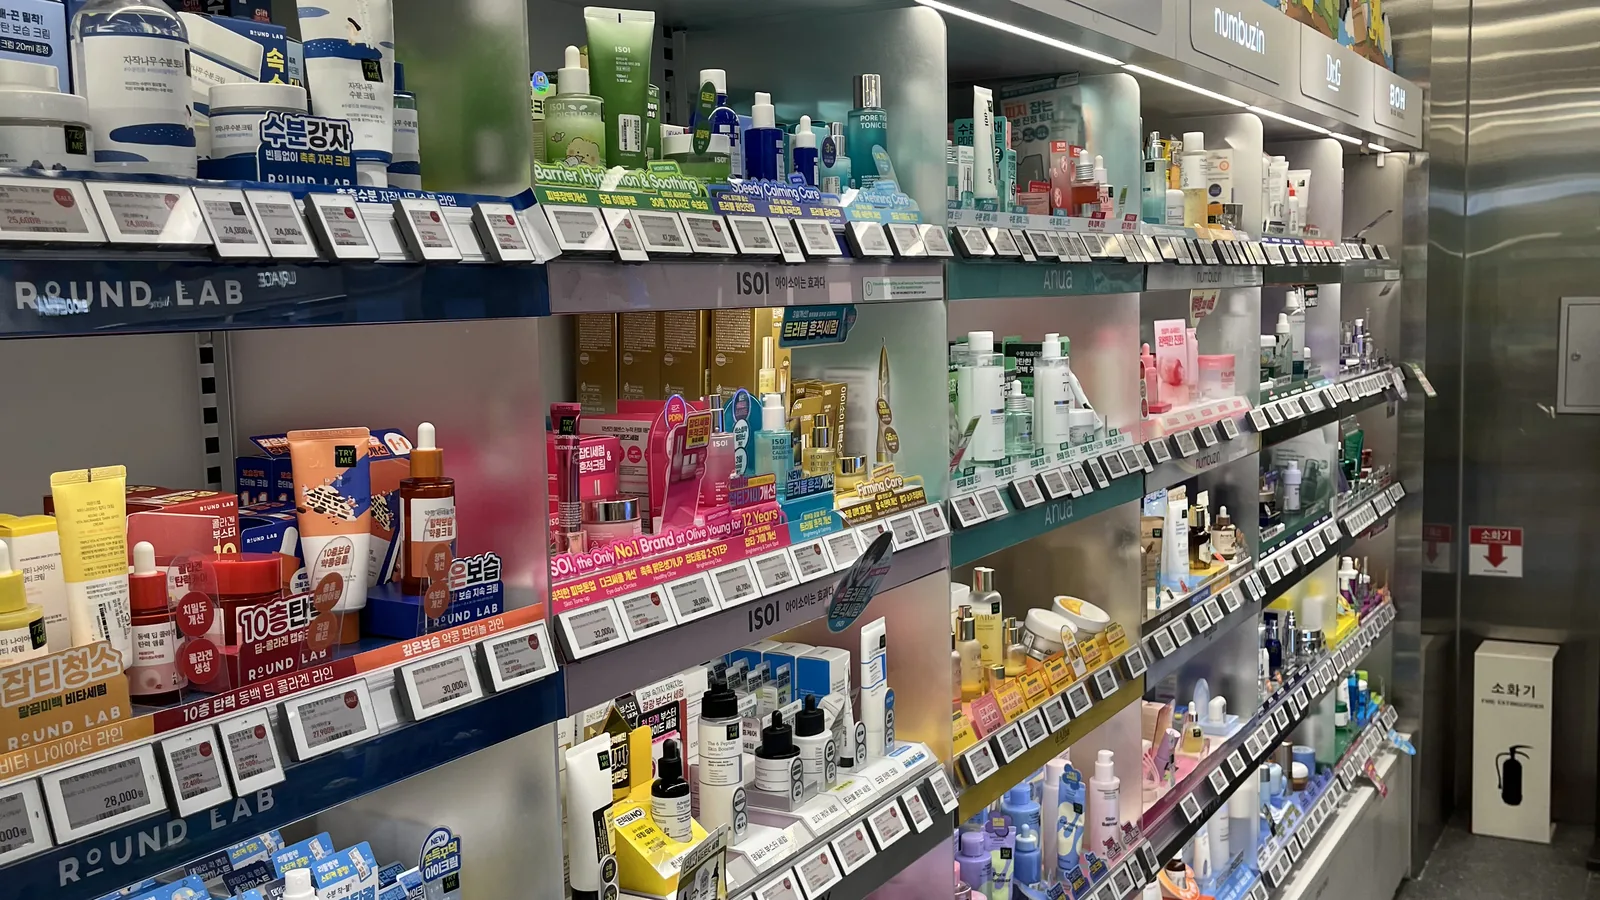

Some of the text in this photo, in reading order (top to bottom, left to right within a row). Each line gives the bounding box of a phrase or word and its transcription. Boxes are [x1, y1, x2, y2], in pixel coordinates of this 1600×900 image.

[1214, 7, 1266, 54] numbuzin
[1030, 100, 1054, 114] 잡는
[262, 114, 351, 151] 수분강자
[265, 149, 351, 167] 빈틈없이 촉촉 자작 크림
[534, 163, 699, 194] Barrier, & Soothing
[731, 181, 820, 201] Speedy Calming Care
[863, 191, 910, 207] Refining Care
[438, 195, 456, 207] 라인
[736, 271, 770, 295] ISOI
[775, 275, 826, 290] 아이소이는 효과다
[1043, 269, 1073, 290] Anua
[15, 280, 152, 310] ROUND
[175, 280, 244, 306] LAB
[783, 319, 840, 338] 트러블 흔적세럼
[562, 418, 574, 426] TRY
[337, 449, 354, 457] TRY
[387, 436, 410, 452] 1+1
[580, 445, 612, 461] 잡티세럼 &
[339, 456, 353, 464] ME
[580, 459, 606, 473] 흔적크림
[855, 475, 904, 497] Firming Care
[1044, 499, 1073, 526] Anua
[212, 516, 235, 530] 콜라겐
[212, 526, 236, 540] 부스터
[576, 509, 778, 570] the Only No.1 Brand at Olive Young for 12 Years
[1481, 530, 1512, 541] 소화기
[706, 544, 728, 558] 2-STEP
[458, 583, 499, 601] 보습 지속 크림
[785, 586, 835, 614] 아이소이는 효과다
[182, 601, 208, 615] 치밀도
[476, 603, 499, 617] LAB
[188, 613, 205, 626] 개선
[748, 604, 780, 633] ISOI
[401, 618, 505, 657] 깊은보습 약콩 판테놀 라인
[188, 649, 214, 665] 콜라겐
[2, 647, 120, 701] 잡티청소
[194, 661, 211, 675] 생성
[248, 657, 294, 681] ROUND
[65, 683, 107, 706] 비타세럼
[183, 666, 334, 722] 10층 탄력 동백 딥 콜라겐 라인
[1490, 682, 1536, 699] 소화기
[660, 706, 677, 720] 부스터
[7, 705, 121, 751] ROUND LAB
[34, 725, 124, 765] 나이아신 라인
[103, 788, 145, 809] 28,000원
[58, 786, 276, 887] ROUND LAB
[430, 833, 446, 846] NEW
[425, 855, 459, 880] 아이크림
